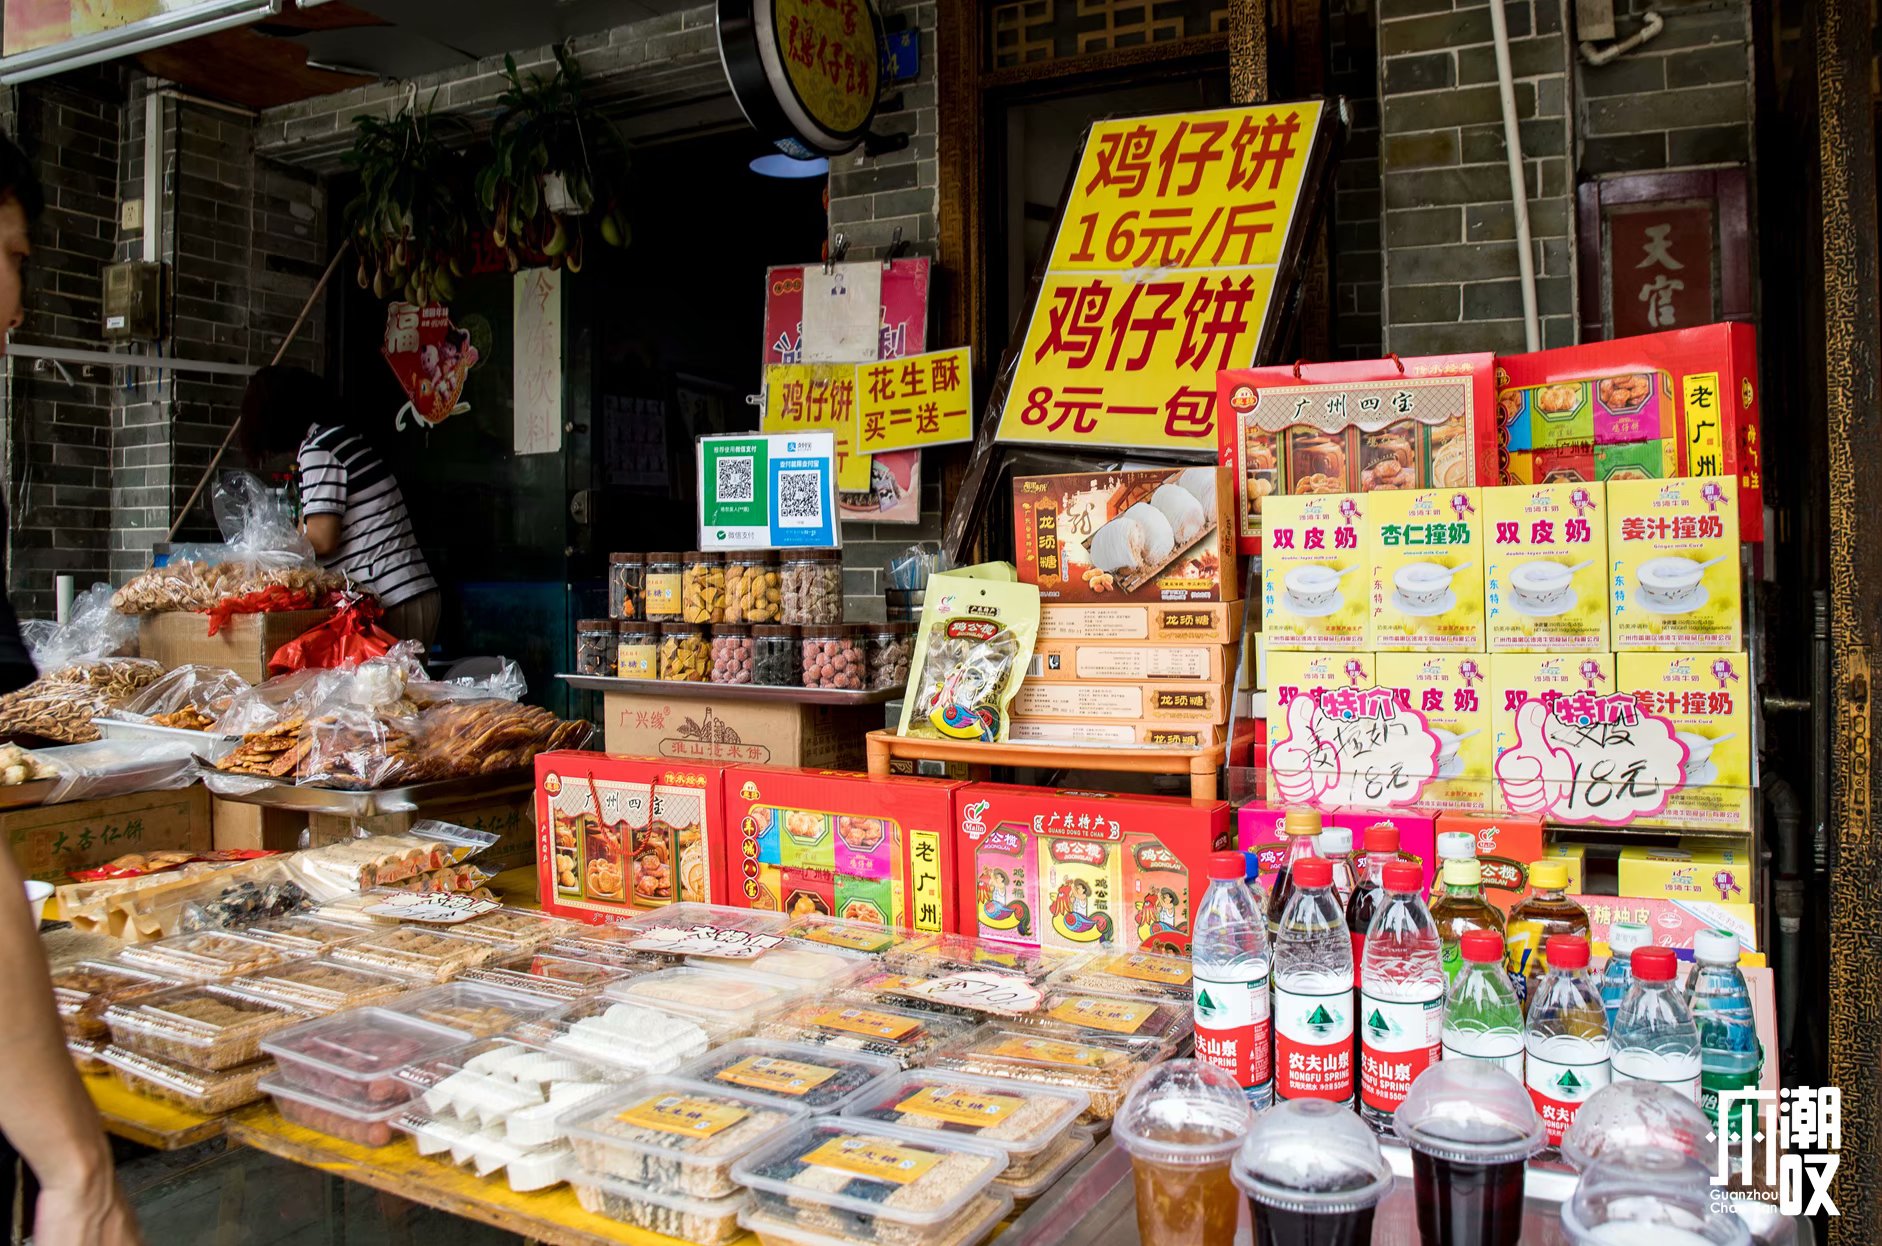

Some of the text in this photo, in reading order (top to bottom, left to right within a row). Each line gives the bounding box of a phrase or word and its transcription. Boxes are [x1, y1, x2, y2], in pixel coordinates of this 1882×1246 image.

[1085, 110, 1300, 199] 鸡仔饼
[1069, 200, 1277, 268] 16元/斤
[1635, 223, 1685, 327] 天官
[386, 301, 420, 354] 福
[1034, 275, 1255, 372] 鸡仔饼
[867, 354, 961, 405] 花生酥
[781, 378, 853, 423] 鸡仔饼
[1020, 385, 1217, 438] 8元一包
[1293, 391, 1415, 420] 广州四宝
[1690, 384, 1718, 477] 老广州
[728, 531, 755, 539] 微信支付
[1273, 526, 1359, 550] 双皮奶
[1380, 522, 1471, 546] 杏仁撞奶
[1496, 518, 1591, 545] 双皮奶
[1621, 515, 1723, 541] 姜汁撞奶
[1039, 516, 1057, 570] 龙须糖
[1265, 567, 1275, 618] 广东特产
[1373, 566, 1383, 618] 广东特产
[1489, 564, 1499, 618] 广东特产
[1614, 560, 1624, 616] 广东特产
[951, 621, 995, 634] 鸡公榄
[1165, 614, 1210, 627] 龙须糖
[1160, 695, 1205, 708] 龙须糖
[1322, 687, 1394, 720] 特价
[1394, 688, 1479, 712] 双皮奶
[1554, 692, 1638, 727] 特价
[1635, 691, 1733, 715] 姜汁撞奶
[620, 709, 666, 731] 广兴缘
[1153, 735, 1196, 745] 龙须糖
[664, 772, 707, 788] 传承经典
[1568, 760, 1660, 810] 18元
[584, 791, 665, 816] 广州四宝
[1048, 812, 1105, 830] 广东特产
[52, 818, 144, 853] 大杏仁饼
[1055, 841, 1101, 858] 鸡公榄
[742, 817, 758, 898] 羊城八宝
[915, 840, 937, 925] 老广州
[1208, 1056, 1237, 1067] SPRING
[1289, 1052, 1349, 1071] 农夫山泉
[1289, 1069, 1349, 1082] NONGFU SPRING
[1290, 1080, 1318, 1091] 饮用天然水
[1379, 1079, 1410, 1091] SPRING
